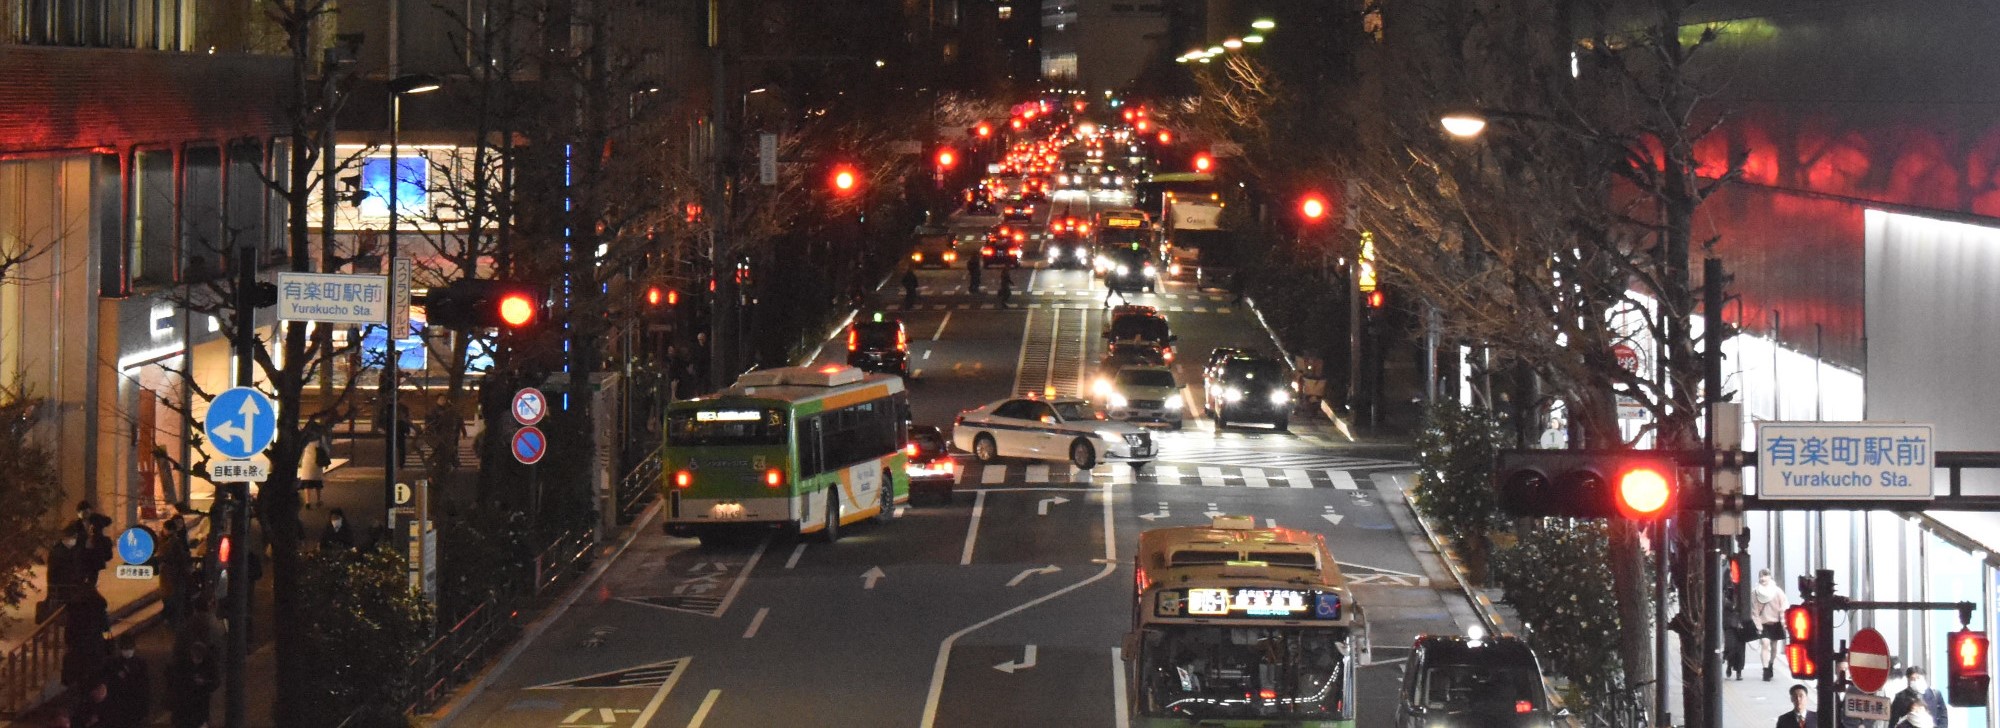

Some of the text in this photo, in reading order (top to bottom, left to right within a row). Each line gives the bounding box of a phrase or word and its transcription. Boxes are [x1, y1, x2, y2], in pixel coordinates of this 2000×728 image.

[283, 281, 382, 303] 有楽町駅前
[396, 262, 408, 336] スクランブル式
[291, 303, 373, 317] Yurakucho Sta.
[1766, 435, 1926, 467] 有楽町駅前
[214, 465, 264, 478] 自転車を除く
[1781, 471, 1912, 487] Yurakucho Sta.
[1847, 698, 1889, 716] 自転車を除く
